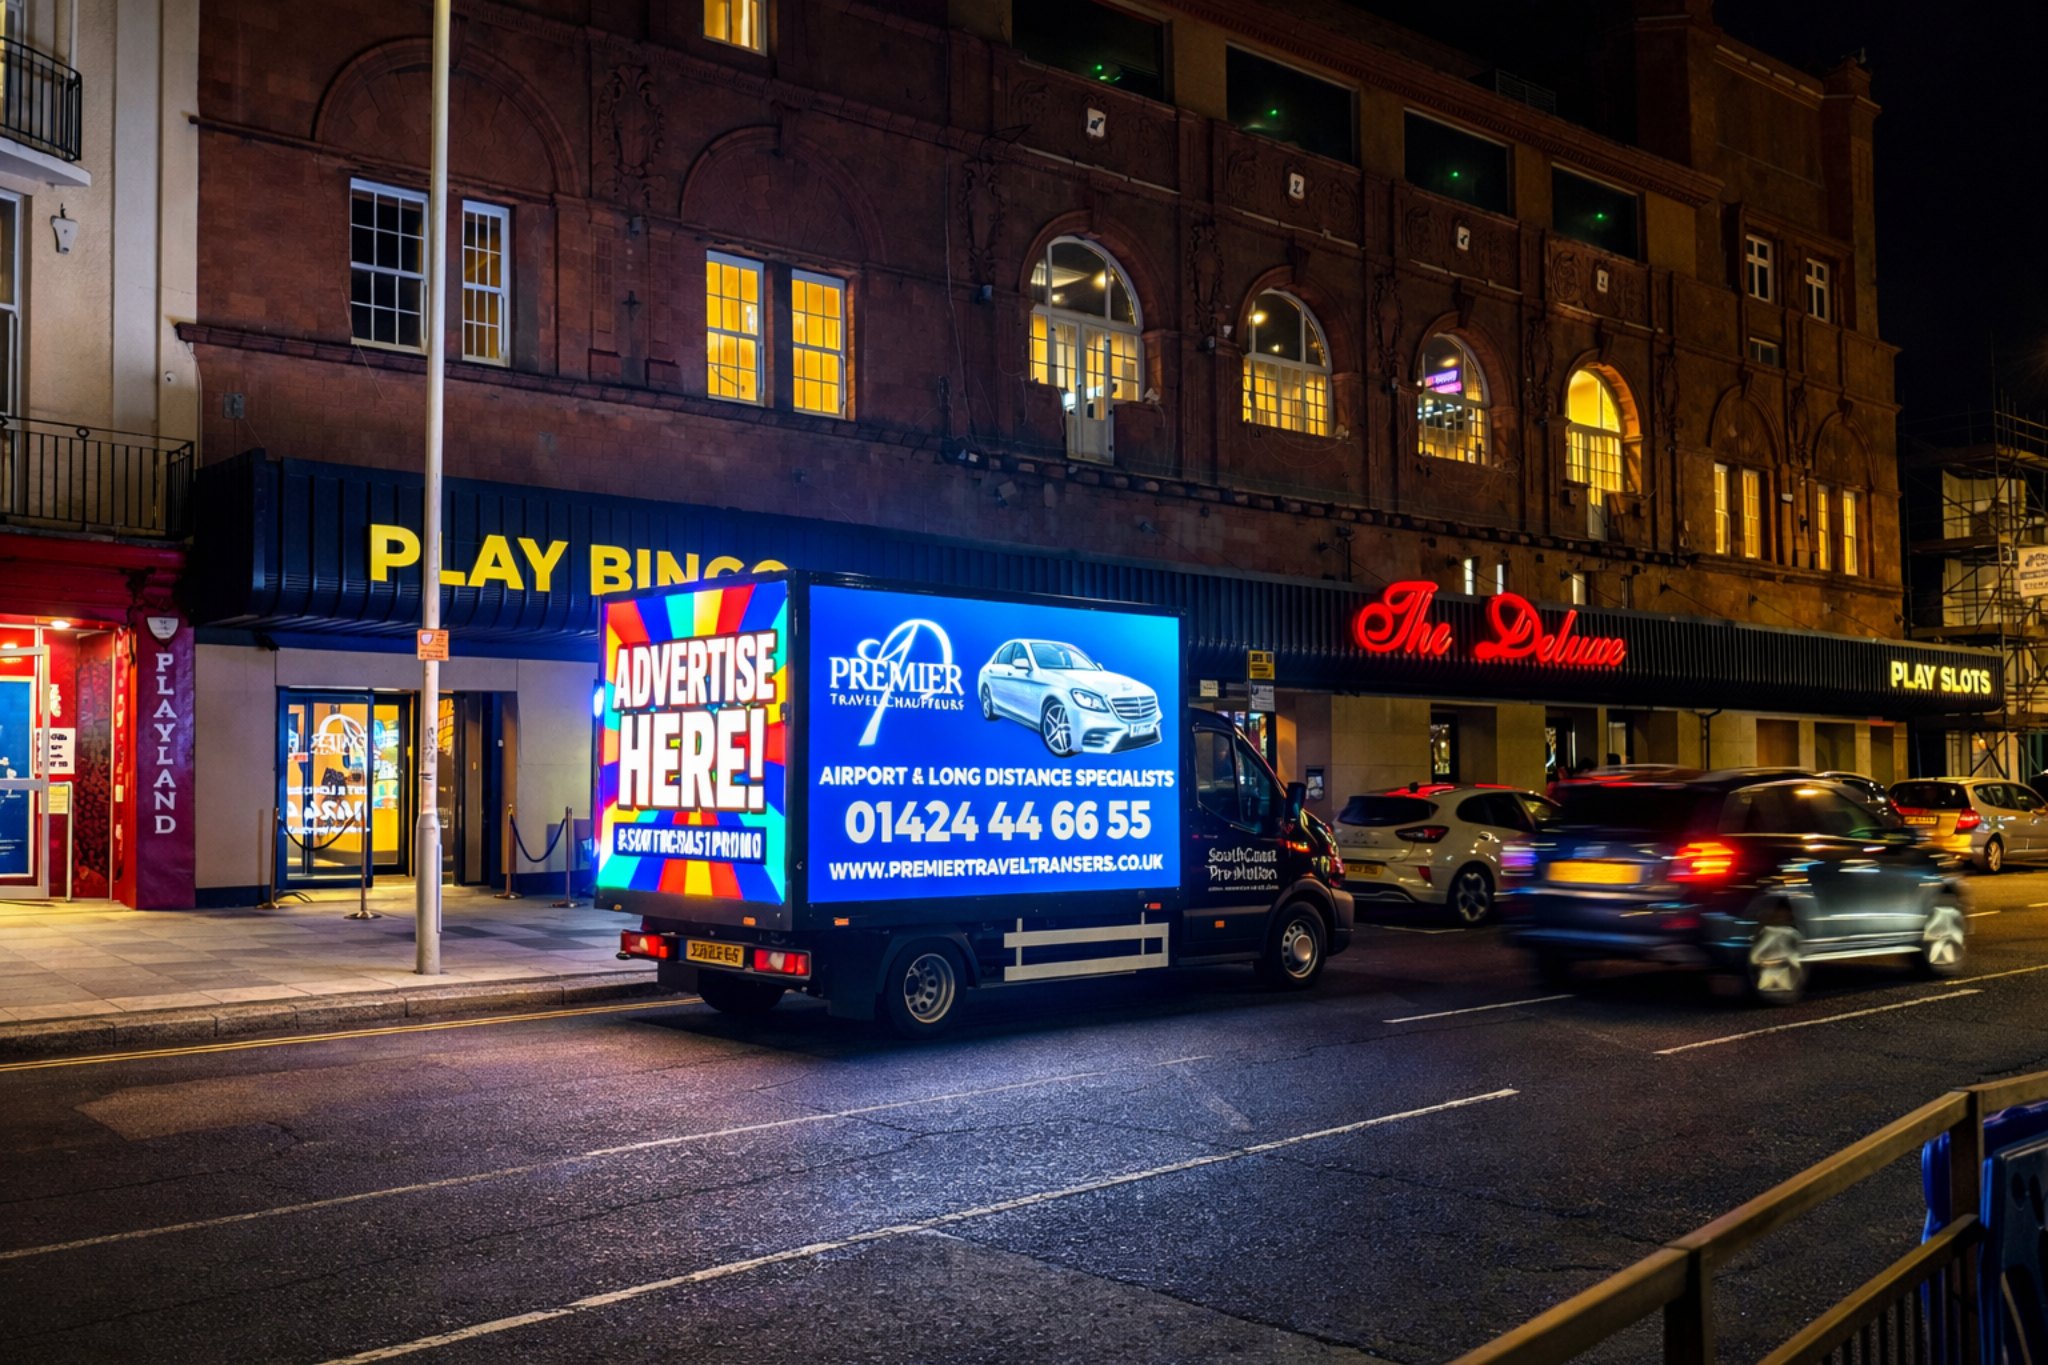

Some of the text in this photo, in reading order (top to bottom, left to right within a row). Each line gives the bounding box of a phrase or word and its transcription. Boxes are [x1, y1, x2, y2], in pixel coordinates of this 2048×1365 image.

[1354, 581, 1626, 666] The Deluxe
[612, 632, 776, 709] ADVERTISE
[829, 656, 965, 697] PREMIER
[1890, 660, 1992, 695] PLAY SLOTS
[830, 693, 878, 707] TRAVEL
[153, 653, 178, 834] PLAYLAND
[617, 707, 765, 810] HERE!
[819, 765, 1175, 788] AIRPORT & LONG DISTANCE SPECIALISTS
[844, 800, 1151, 845] 01424 44 66 55
